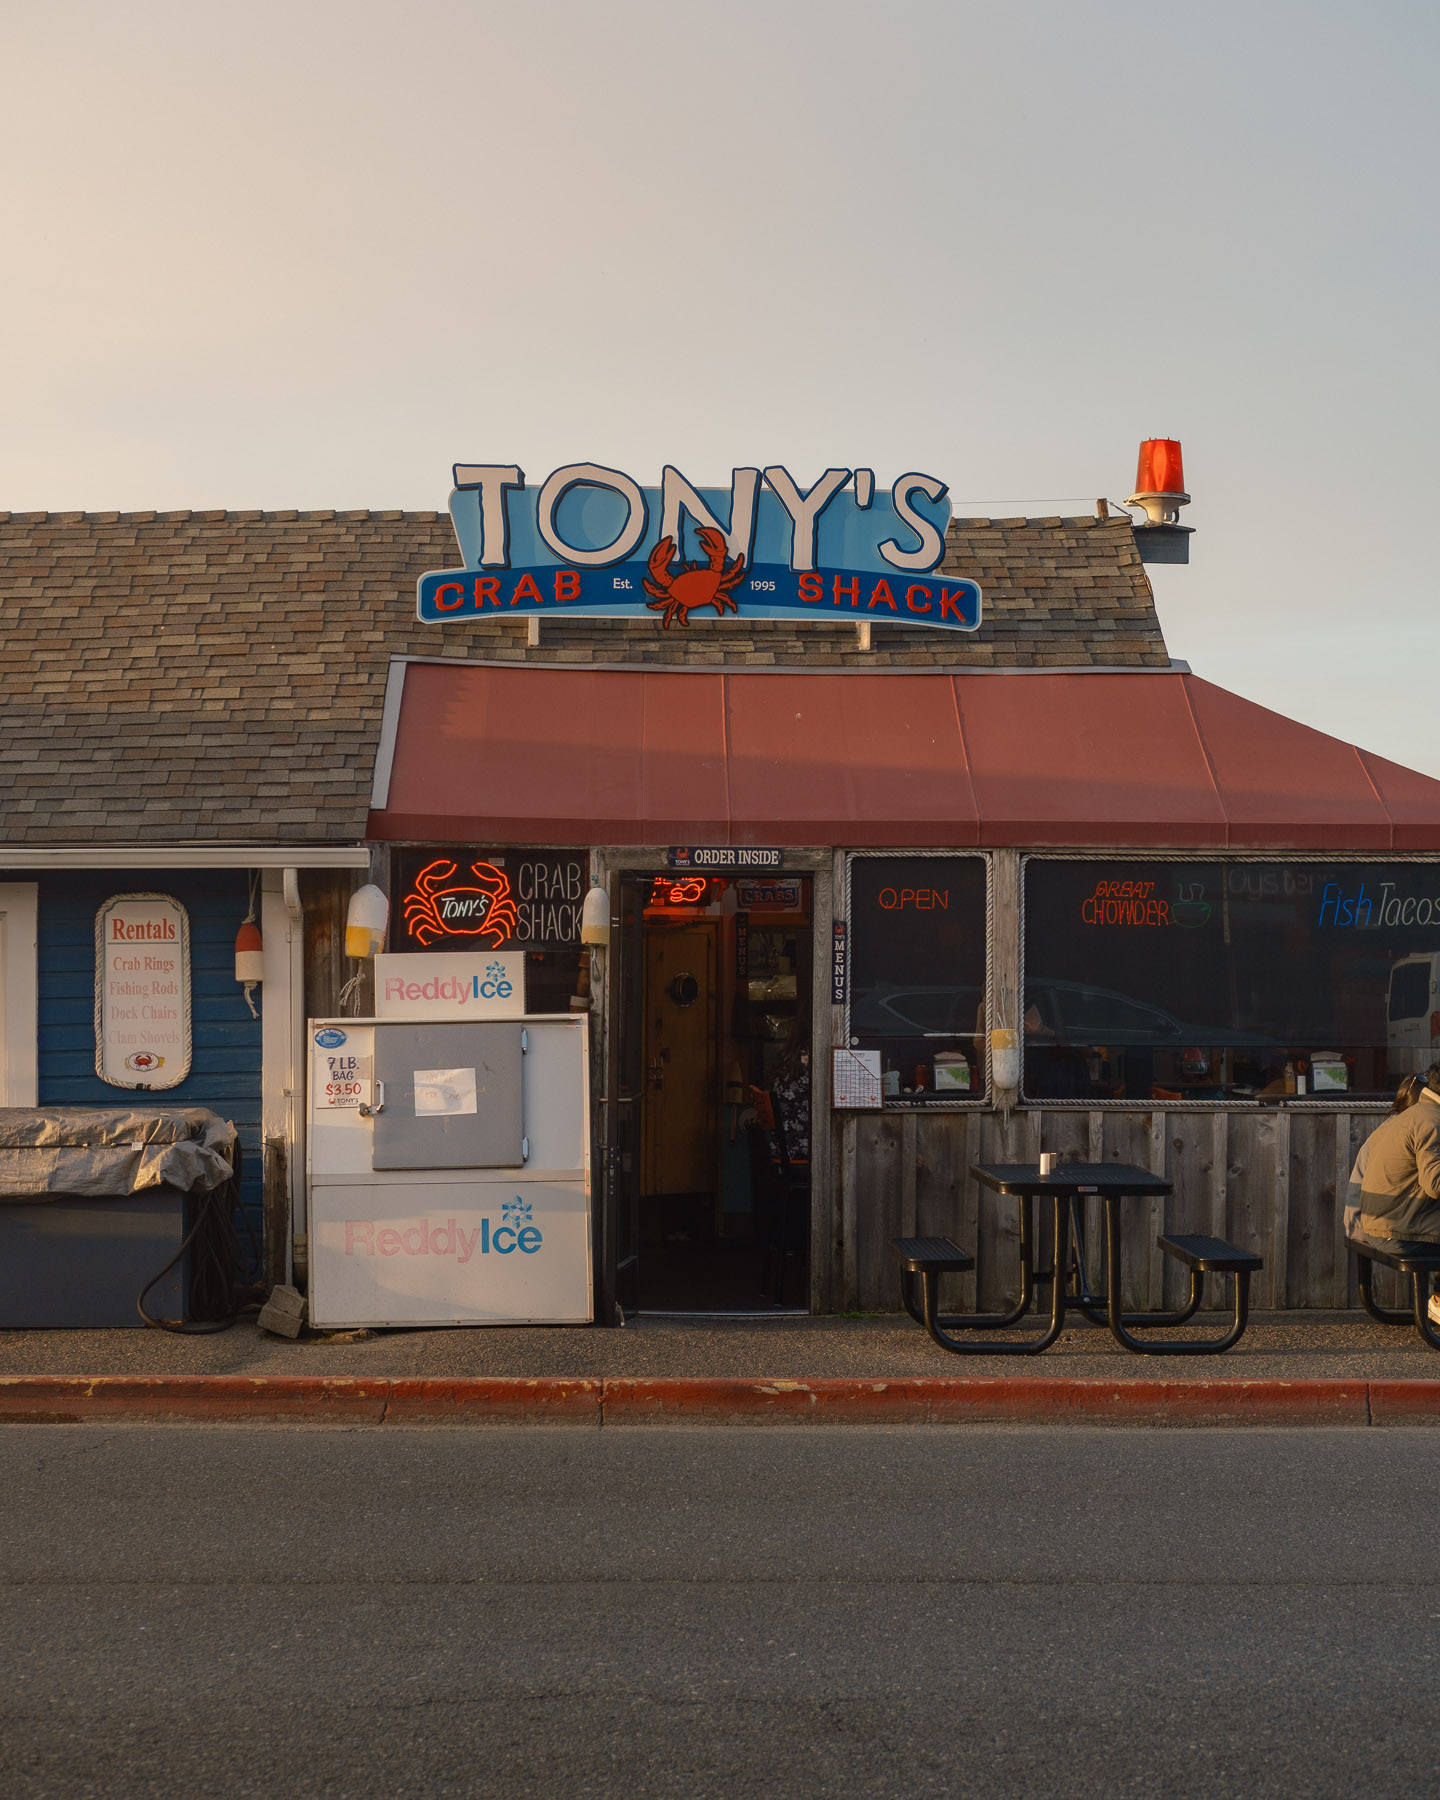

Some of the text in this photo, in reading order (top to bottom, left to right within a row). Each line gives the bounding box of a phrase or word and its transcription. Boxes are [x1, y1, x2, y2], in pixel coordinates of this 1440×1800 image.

[452, 461, 949, 573] TONY'S
[433, 570, 582, 612] CRAB
[613, 577, 633, 590] Est.
[750, 579, 776, 592] 1995
[797, 572, 968, 621] SHACK
[694, 849, 779, 865] ORDER INSIDE
[518, 862, 581, 900] CRAB
[1094, 880, 1155, 899] GREAT
[441, 894, 489, 919] TONY'S
[879, 887, 949, 910] OPEN
[1318, 882, 1372, 926] Fish
[515, 903, 582, 941] SHACK
[1082, 898, 1170, 926] CHOWDER
[111, 918, 175, 940] Rentals
[113, 956, 175, 974] Crab Rings
[834, 940, 845, 999] MENUS
[109, 981, 179, 998] Fishing Rods
[111, 1006, 177, 1020] Dock Chairs
[109, 1031, 180, 1044] Clam Shovels
[327, 1056, 359, 1070] 7 LB.
[332, 1070, 354, 1080] BAG
[325, 1082, 361, 1096] $3.50
